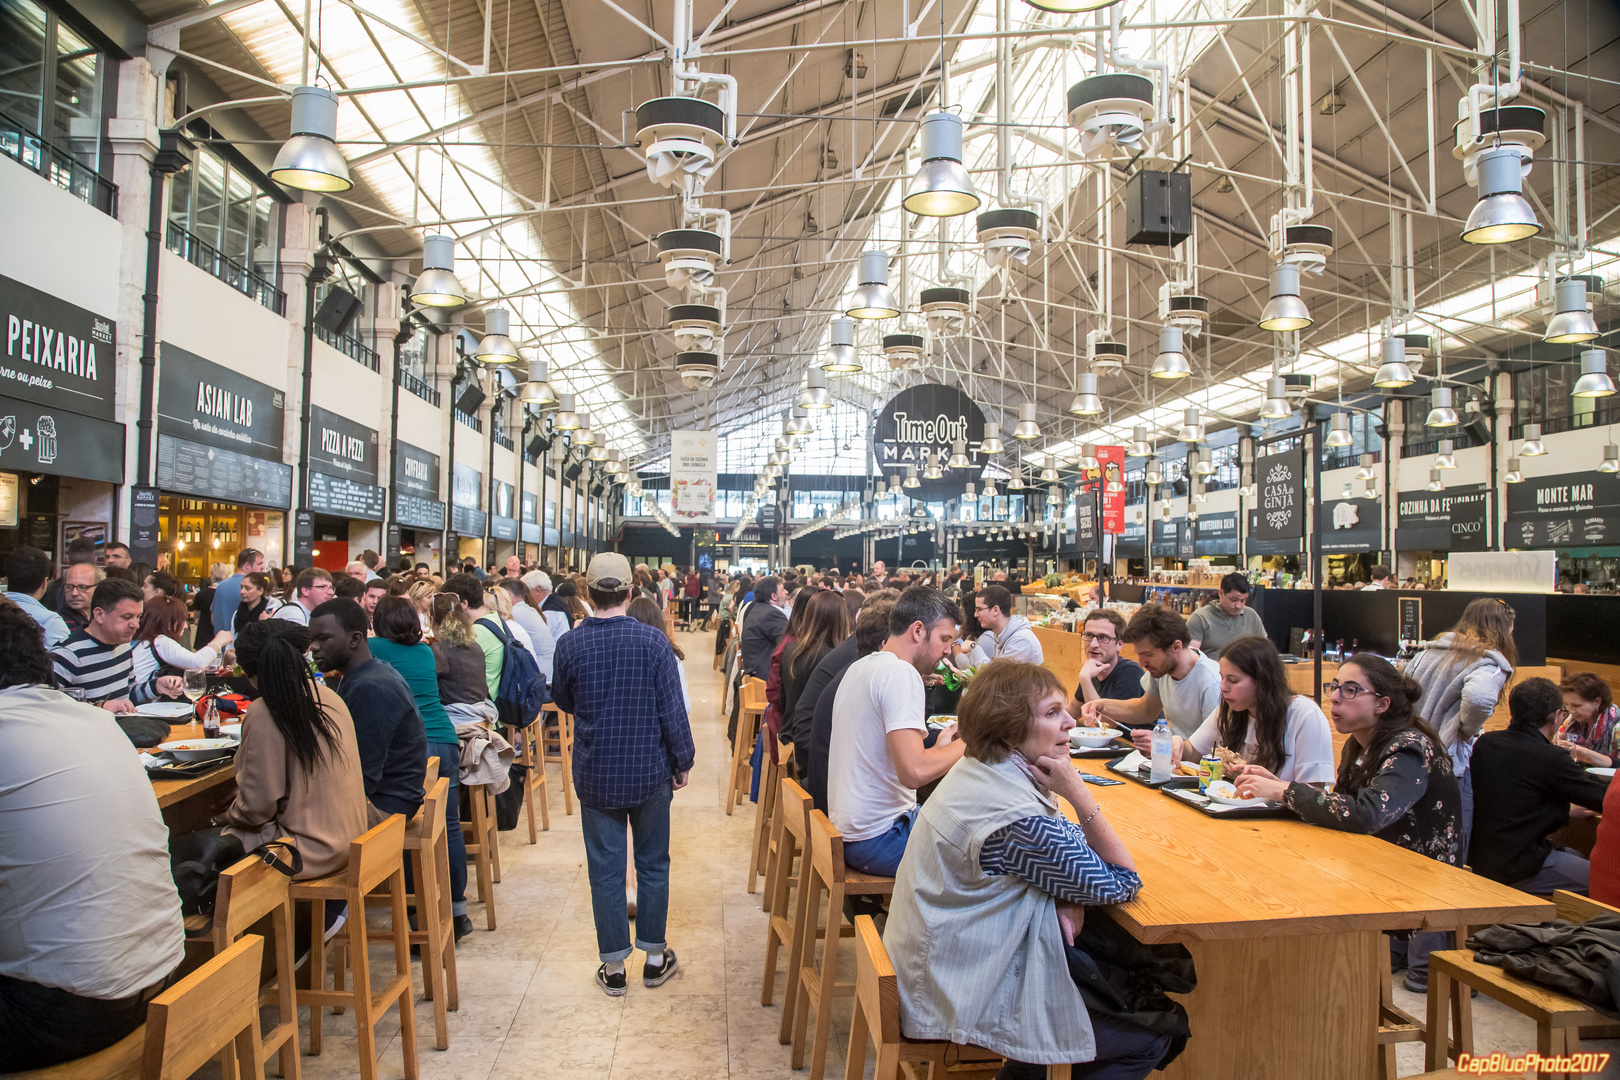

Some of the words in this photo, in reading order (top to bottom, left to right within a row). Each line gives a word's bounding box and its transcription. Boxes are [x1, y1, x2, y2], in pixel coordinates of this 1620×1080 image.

[8, 314, 97, 381] PEIXARIA
[17, 371, 29, 383] ou
[196, 381, 231, 421] ASIAN
[233, 394, 253, 427] LAB
[893, 411, 936, 443] Time
[935, 413, 968, 444] Out
[321, 427, 340, 456] PIZZA
[341, 434, 347, 457] A
[347, 436, 364, 462] PEZZI
[883, 446, 981, 462] MARKT
[1264, 483, 1288, 497] CASA
[1536, 486, 1568, 504] MONTE
[1571, 483, 1594, 502] MAR
[1264, 495, 1294, 509] GINJA
[1400, 500, 1428, 515] COZINHA
[1430, 498, 1440, 513] DA
[1223, 518, 1235, 529] SILVA
[1452, 522, 1481, 534] CINCO
